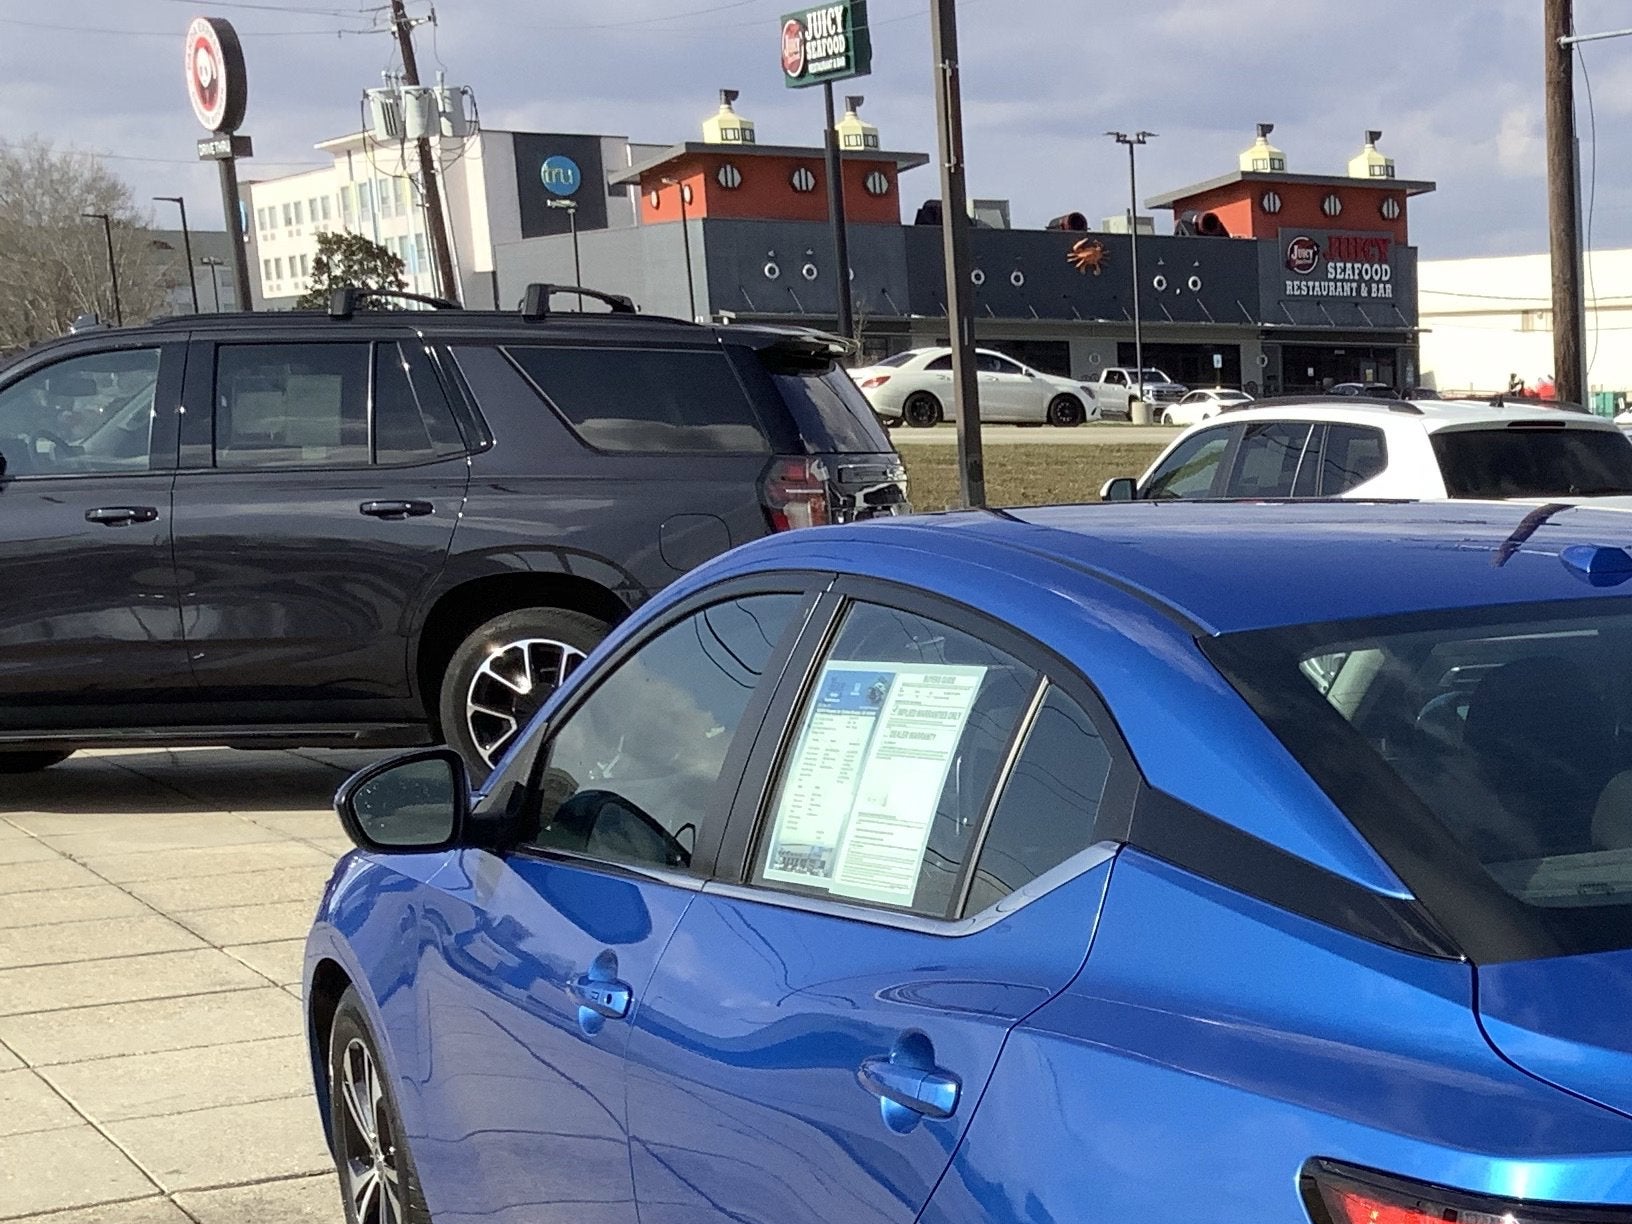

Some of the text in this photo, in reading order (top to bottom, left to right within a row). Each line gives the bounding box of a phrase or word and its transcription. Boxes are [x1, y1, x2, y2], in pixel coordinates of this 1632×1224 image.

[805, 5, 844, 41] JUICY
[805, 34, 846, 60] SEAFOOD
[543, 166, 574, 184] tru
[1322, 235, 1390, 263] JUICY
[1327, 262, 1391, 281] SEAFOOD
[1285, 280, 1393, 298] RESTAURANT & BAR
